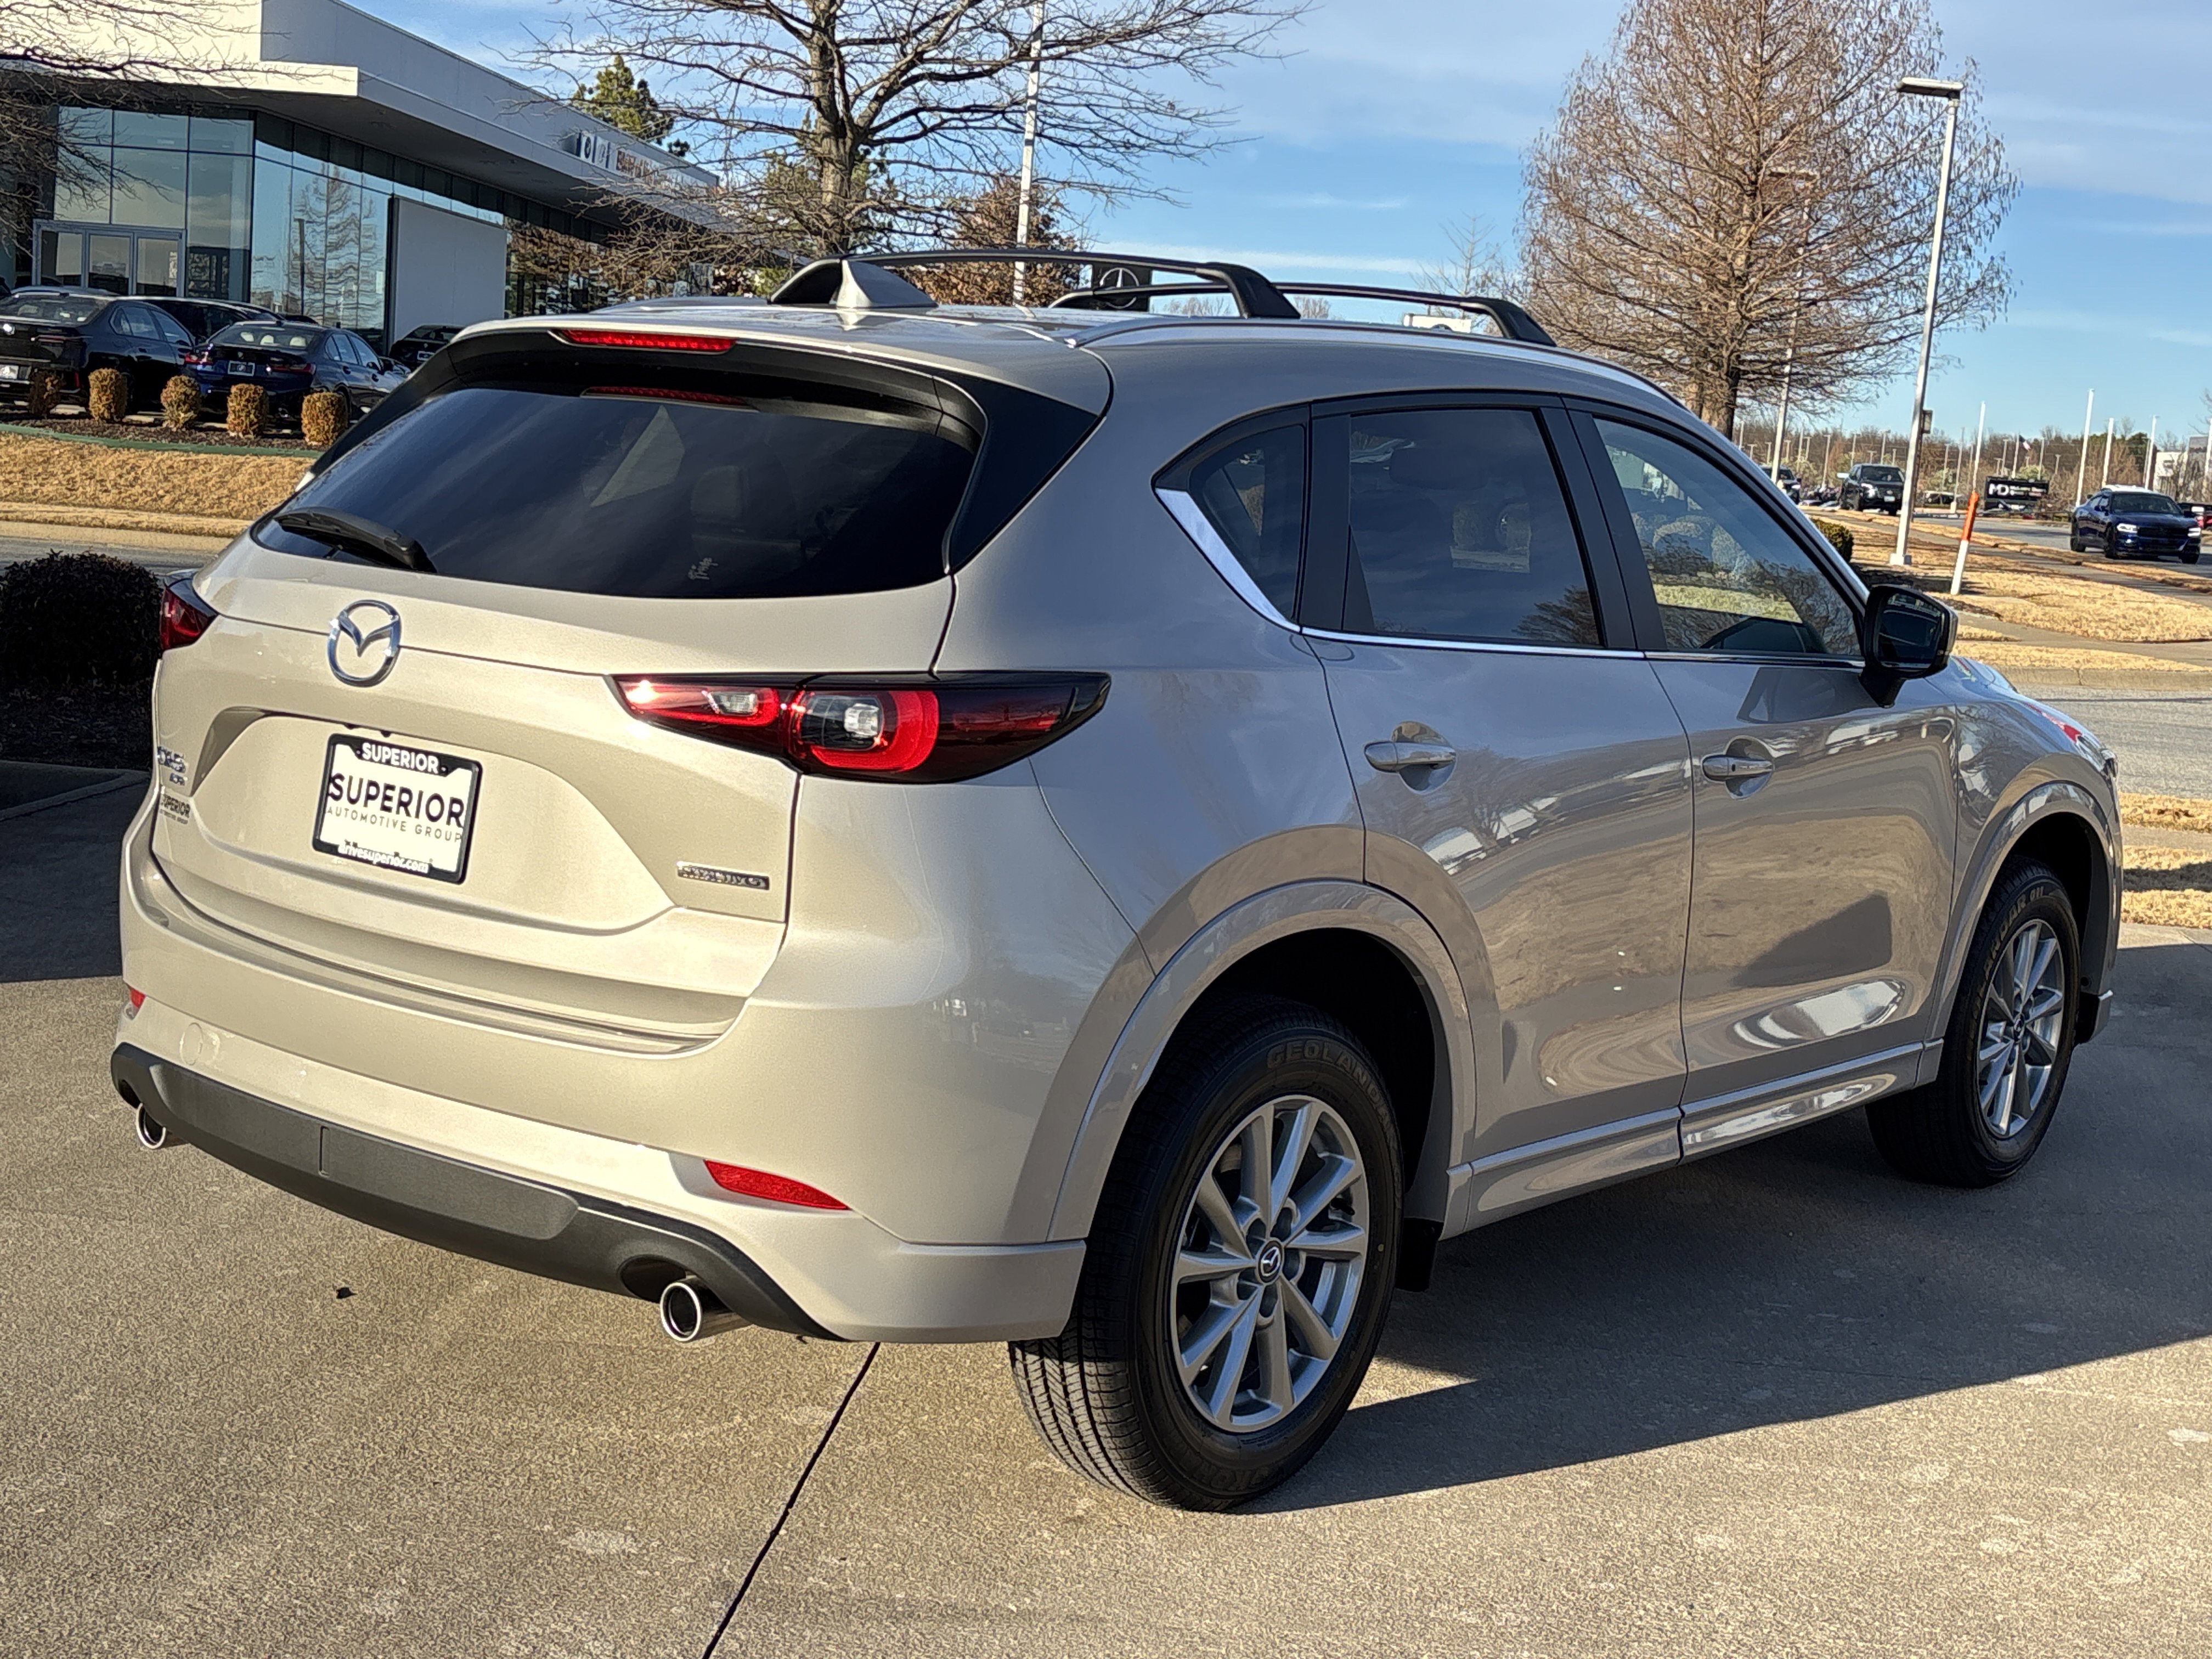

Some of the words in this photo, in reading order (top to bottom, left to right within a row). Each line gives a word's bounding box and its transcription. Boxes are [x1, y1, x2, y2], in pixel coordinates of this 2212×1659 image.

[362, 742, 439, 774] SUPERIOR
[328, 772, 464, 828] SUPERIOR
[327, 806, 407, 832] AUTOMOTIVE
[415, 824, 462, 843] GROUP
